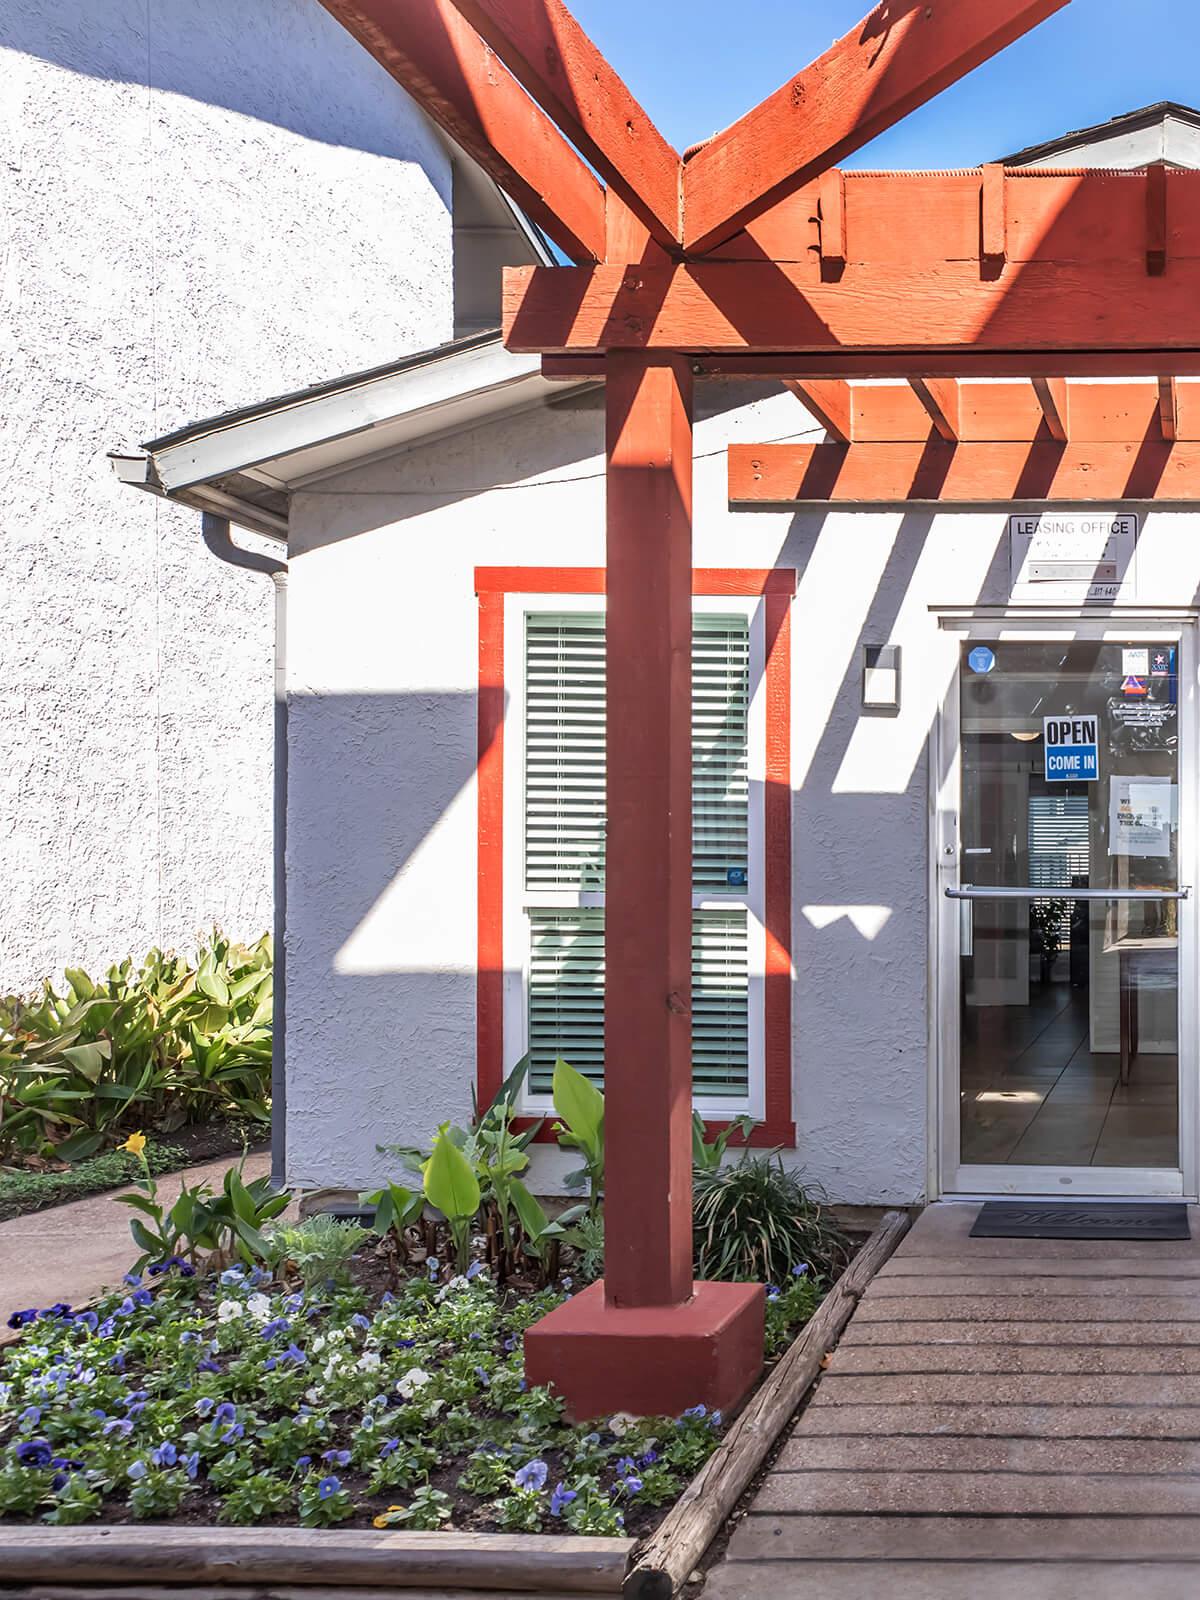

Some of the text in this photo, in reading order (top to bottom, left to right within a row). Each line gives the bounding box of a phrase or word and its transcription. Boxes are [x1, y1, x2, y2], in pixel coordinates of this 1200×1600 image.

[1017, 521, 1129, 535] LEASING OFFICE
[1047, 721, 1095, 745] OPEN
[1048, 755, 1095, 770] COME IN
